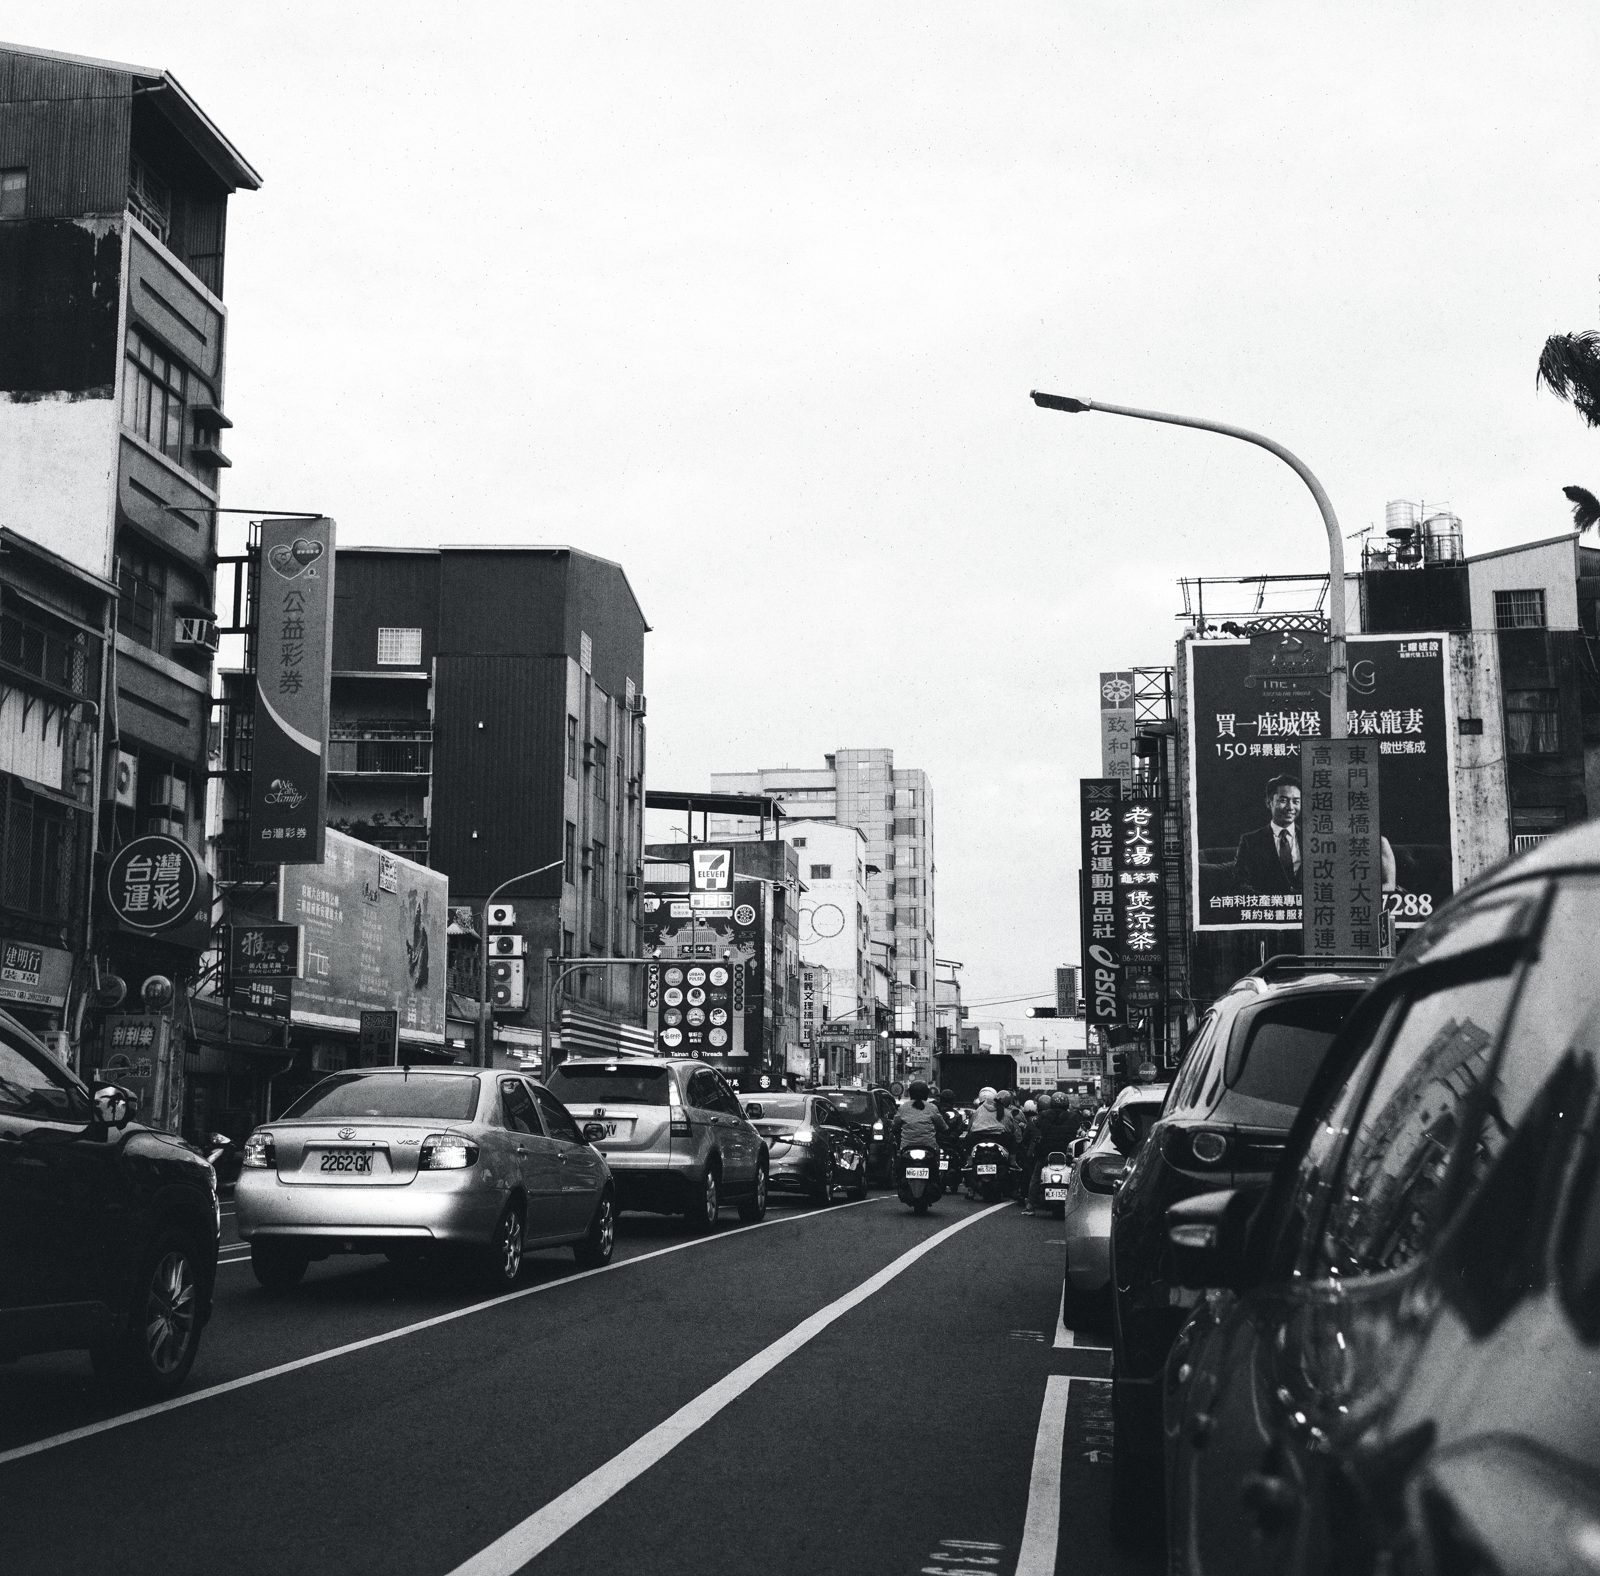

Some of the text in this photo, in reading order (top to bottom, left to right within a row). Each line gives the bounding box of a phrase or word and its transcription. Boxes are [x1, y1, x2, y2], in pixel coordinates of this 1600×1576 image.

[280, 590, 305, 694] 公益彩券
[1216, 711, 1321, 738] 買一座城堡
[1380, 740, 1427, 755] 傲世落成
[261, 827, 307, 839] 台灣彩券
[1123, 805, 1154, 866] 老火湯
[1347, 745, 1372, 950] 東門陸橋禁行大型車
[125, 852, 182, 883] 台灣
[1089, 806, 1116, 940] 必成行運動用品社
[122, 882, 181, 912] 運彩
[1125, 890, 1157, 951] 煲涼茶
[5, 946, 41, 971] 建明行
[112, 1026, 155, 1046] 刮刮樂
